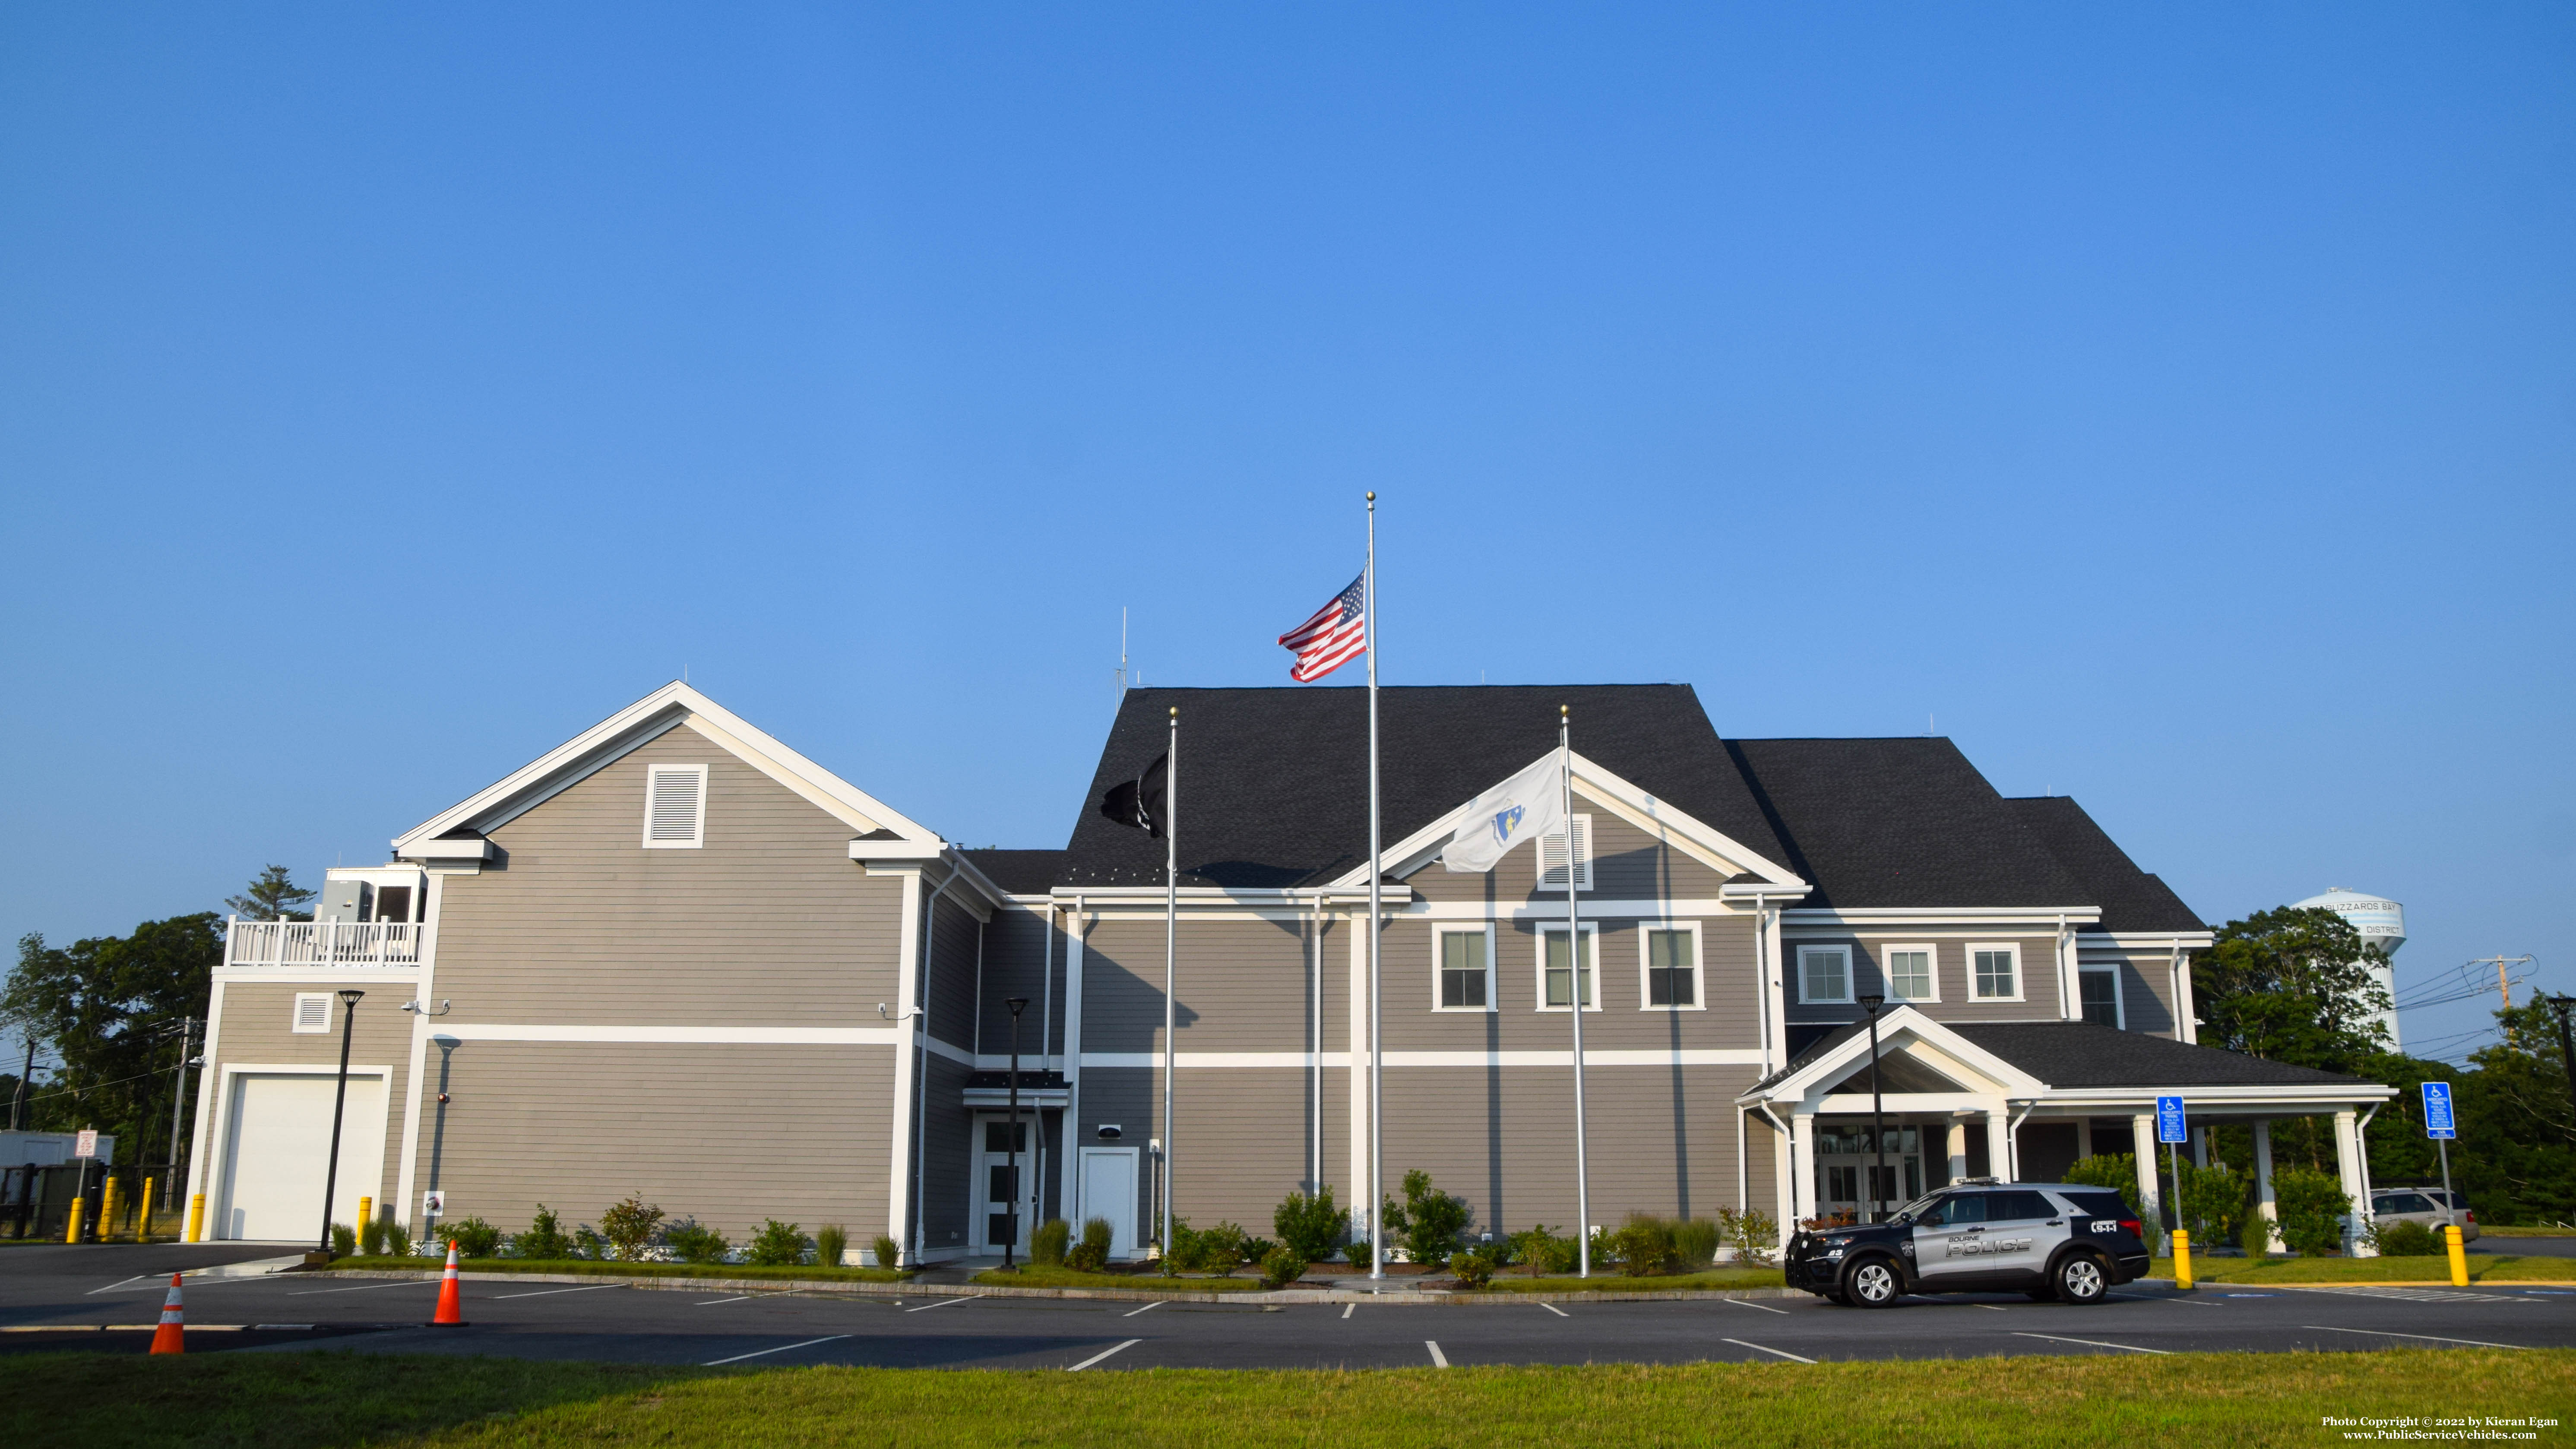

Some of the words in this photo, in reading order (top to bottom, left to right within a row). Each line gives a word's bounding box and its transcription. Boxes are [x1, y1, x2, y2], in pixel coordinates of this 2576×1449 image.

[2326, 903, 2379, 911] BUZZARDS
[2382, 903, 2396, 911] BAY
[2367, 926, 2399, 934] DISTRICT
[2096, 1224, 2117, 1233] 9-1-1
[1946, 1238, 2032, 1257] POLICE
